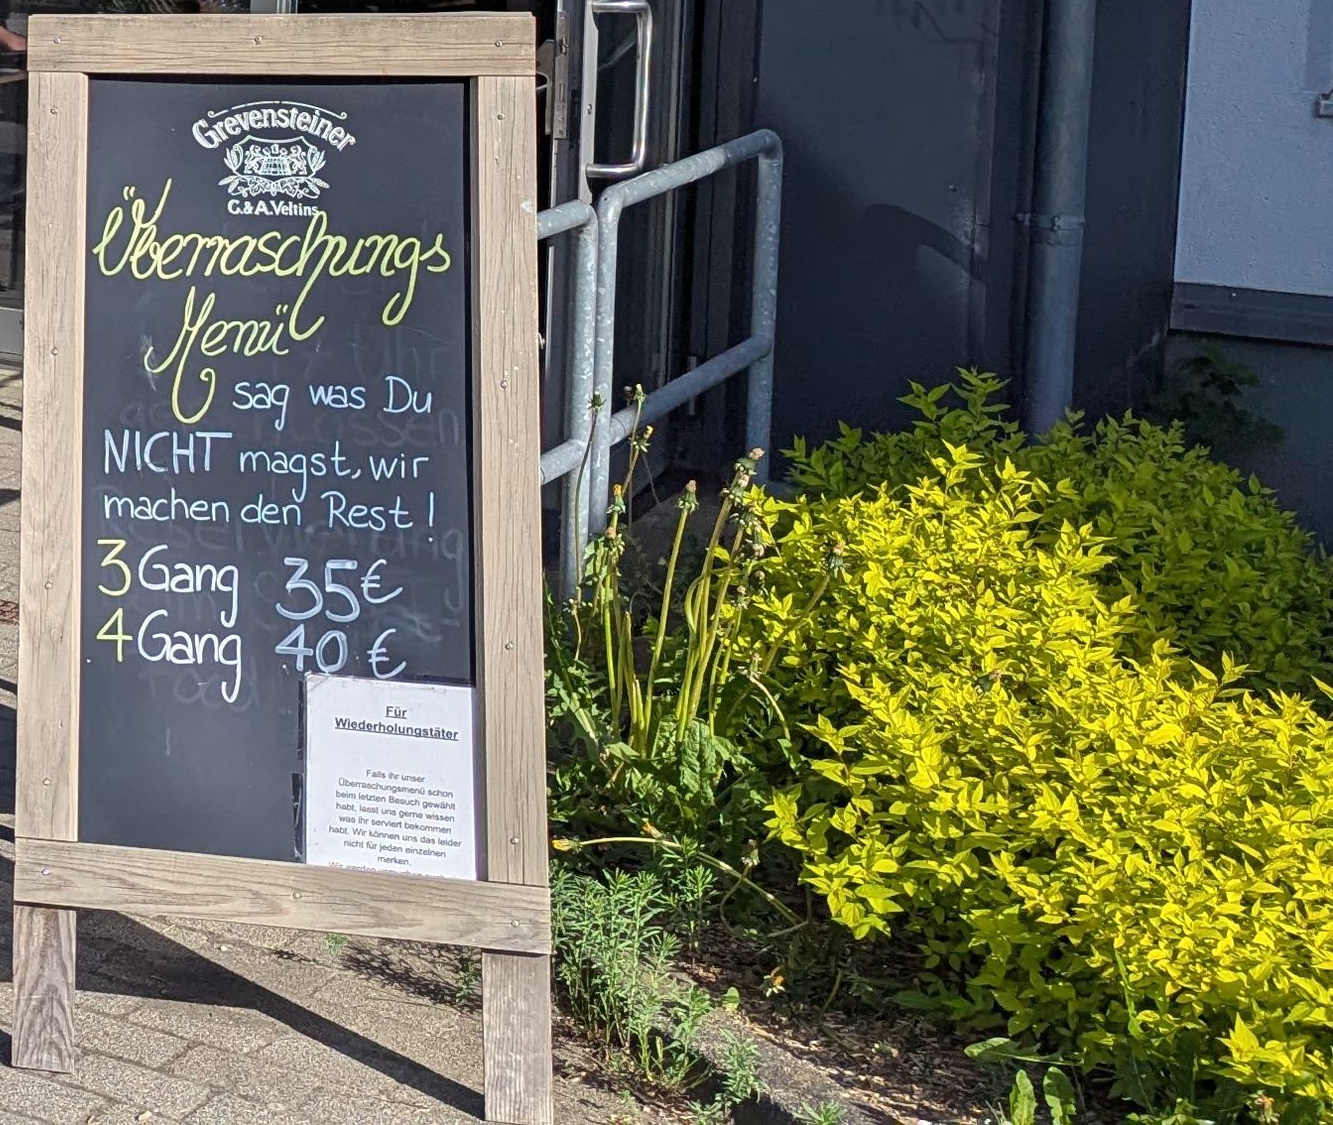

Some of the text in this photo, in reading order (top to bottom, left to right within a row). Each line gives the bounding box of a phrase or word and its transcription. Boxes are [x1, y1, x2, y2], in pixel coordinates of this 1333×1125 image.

[192, 107, 357, 152] Grevensteiner
[92, 177, 451, 341] Überraschungs
[144, 286, 289, 424] Menü
[233, 381, 290, 432] sag
[308, 383, 367, 409] was
[383, 376, 432, 414] Du
[104, 429, 430, 503] NICHT magst, wir
[104, 488, 229, 523] machen
[240, 493, 301, 525] den
[385, 705, 407, 719] Für
[334, 716, 459, 741] Wiederholungstäter
[366, 769, 425, 783] Falls ihr unser
[338, 777, 454, 798] Überraschungsmenü schon
[335, 790, 456, 810] beim letzten Besuch gewählt
[335, 802, 455, 823] habt, lasst uns gerne wissen
[338, 815, 451, 834] was ihr serviert bekommen
[352, 827, 367, 836] Wir
[369, 830, 400, 840] können
[402, 834, 418, 842] uns
[420, 835, 436, 845] das
[438, 837, 462, 847] leider
[343, 839, 446, 858] nicht für jeden einzelnen
[377, 855, 412, 866] merken.
